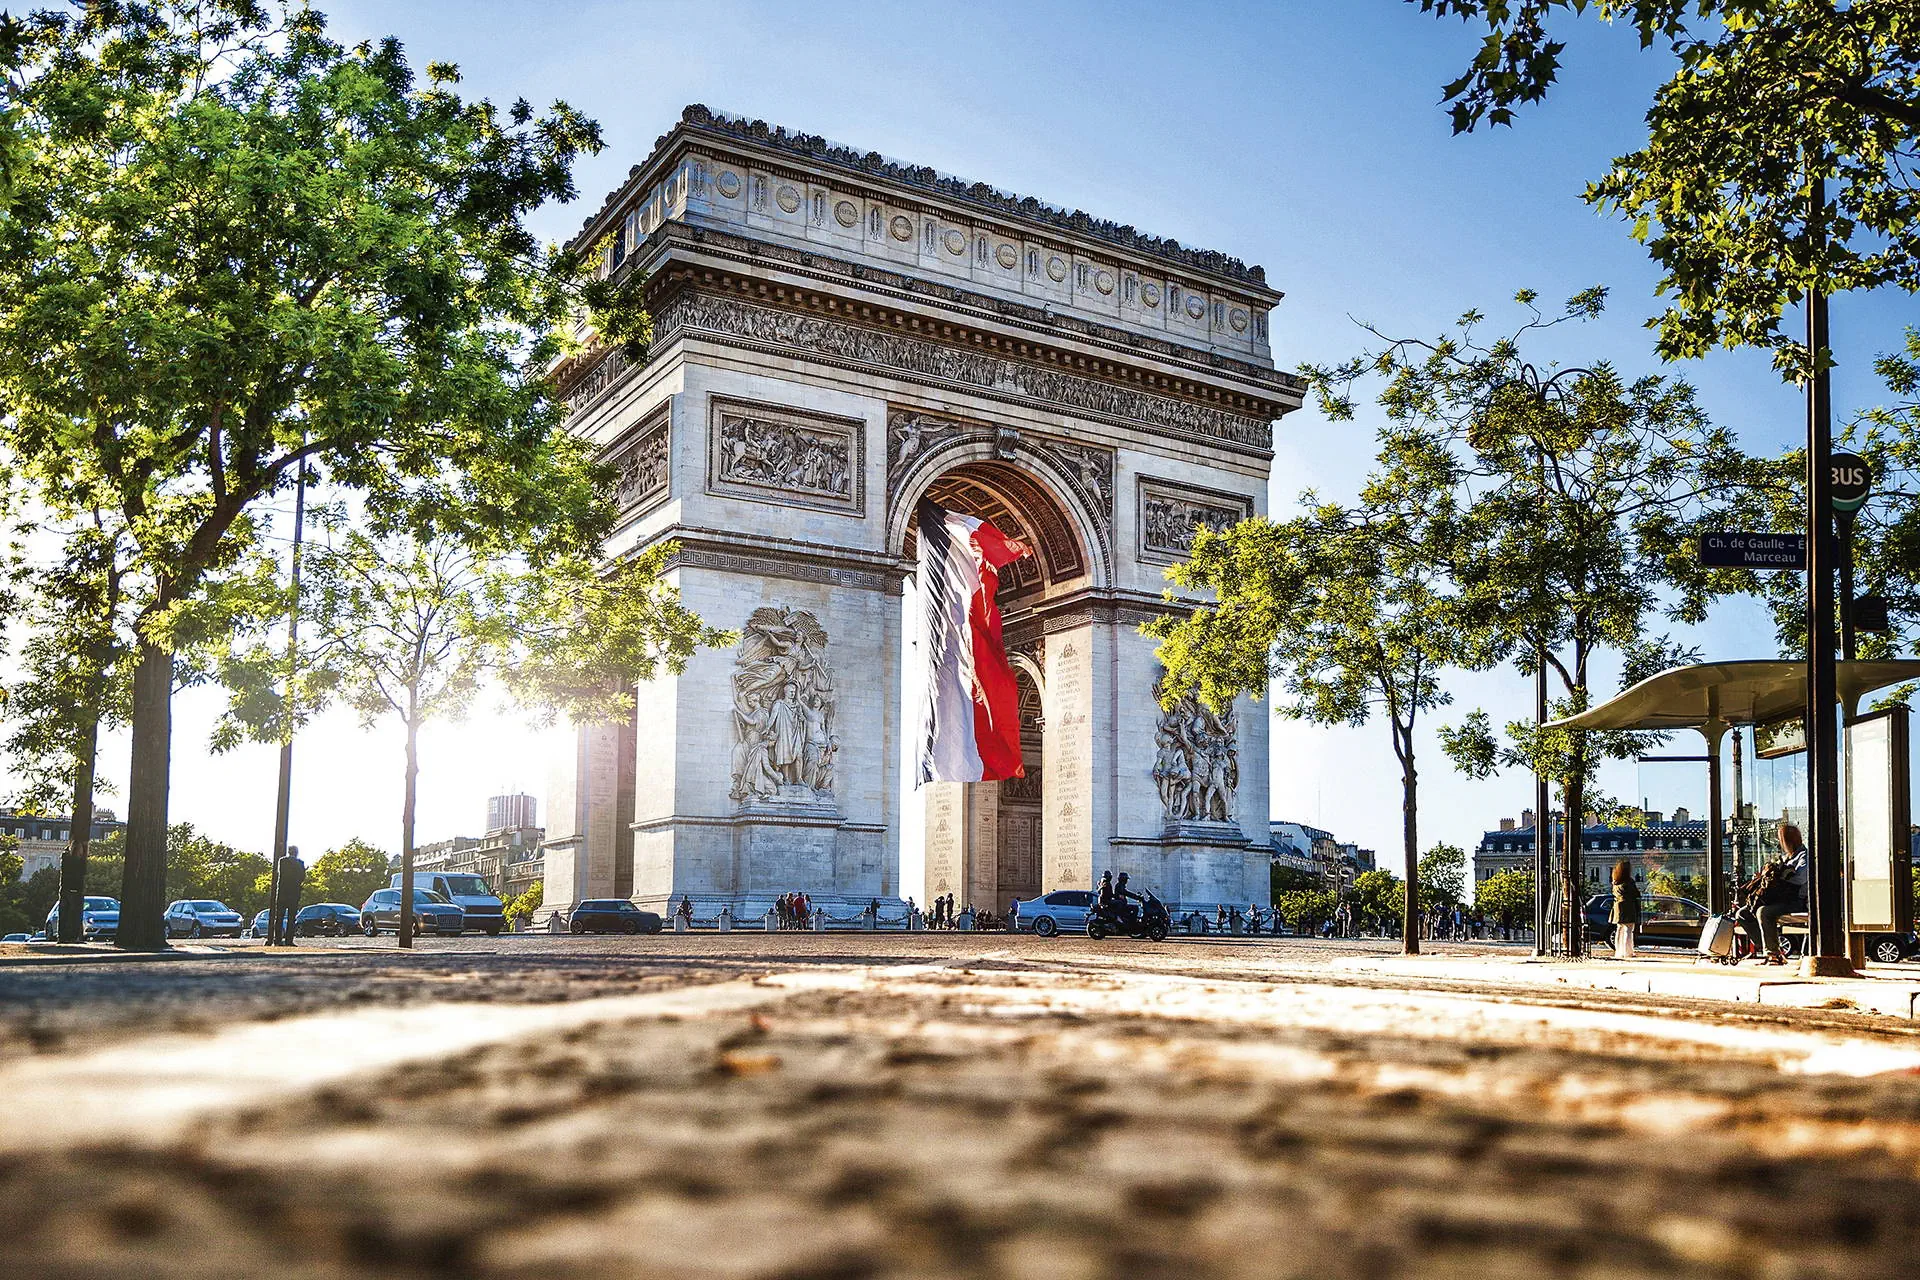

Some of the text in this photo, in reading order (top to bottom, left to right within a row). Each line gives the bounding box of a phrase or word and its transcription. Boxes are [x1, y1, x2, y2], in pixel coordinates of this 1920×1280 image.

[1831, 467, 1864, 486] BUS
[1708, 538, 1727, 548] Ch.
[1730, 538, 1745, 549] de
[1748, 538, 1785, 549] Gaulle
[1744, 551, 1796, 562] Marceau
